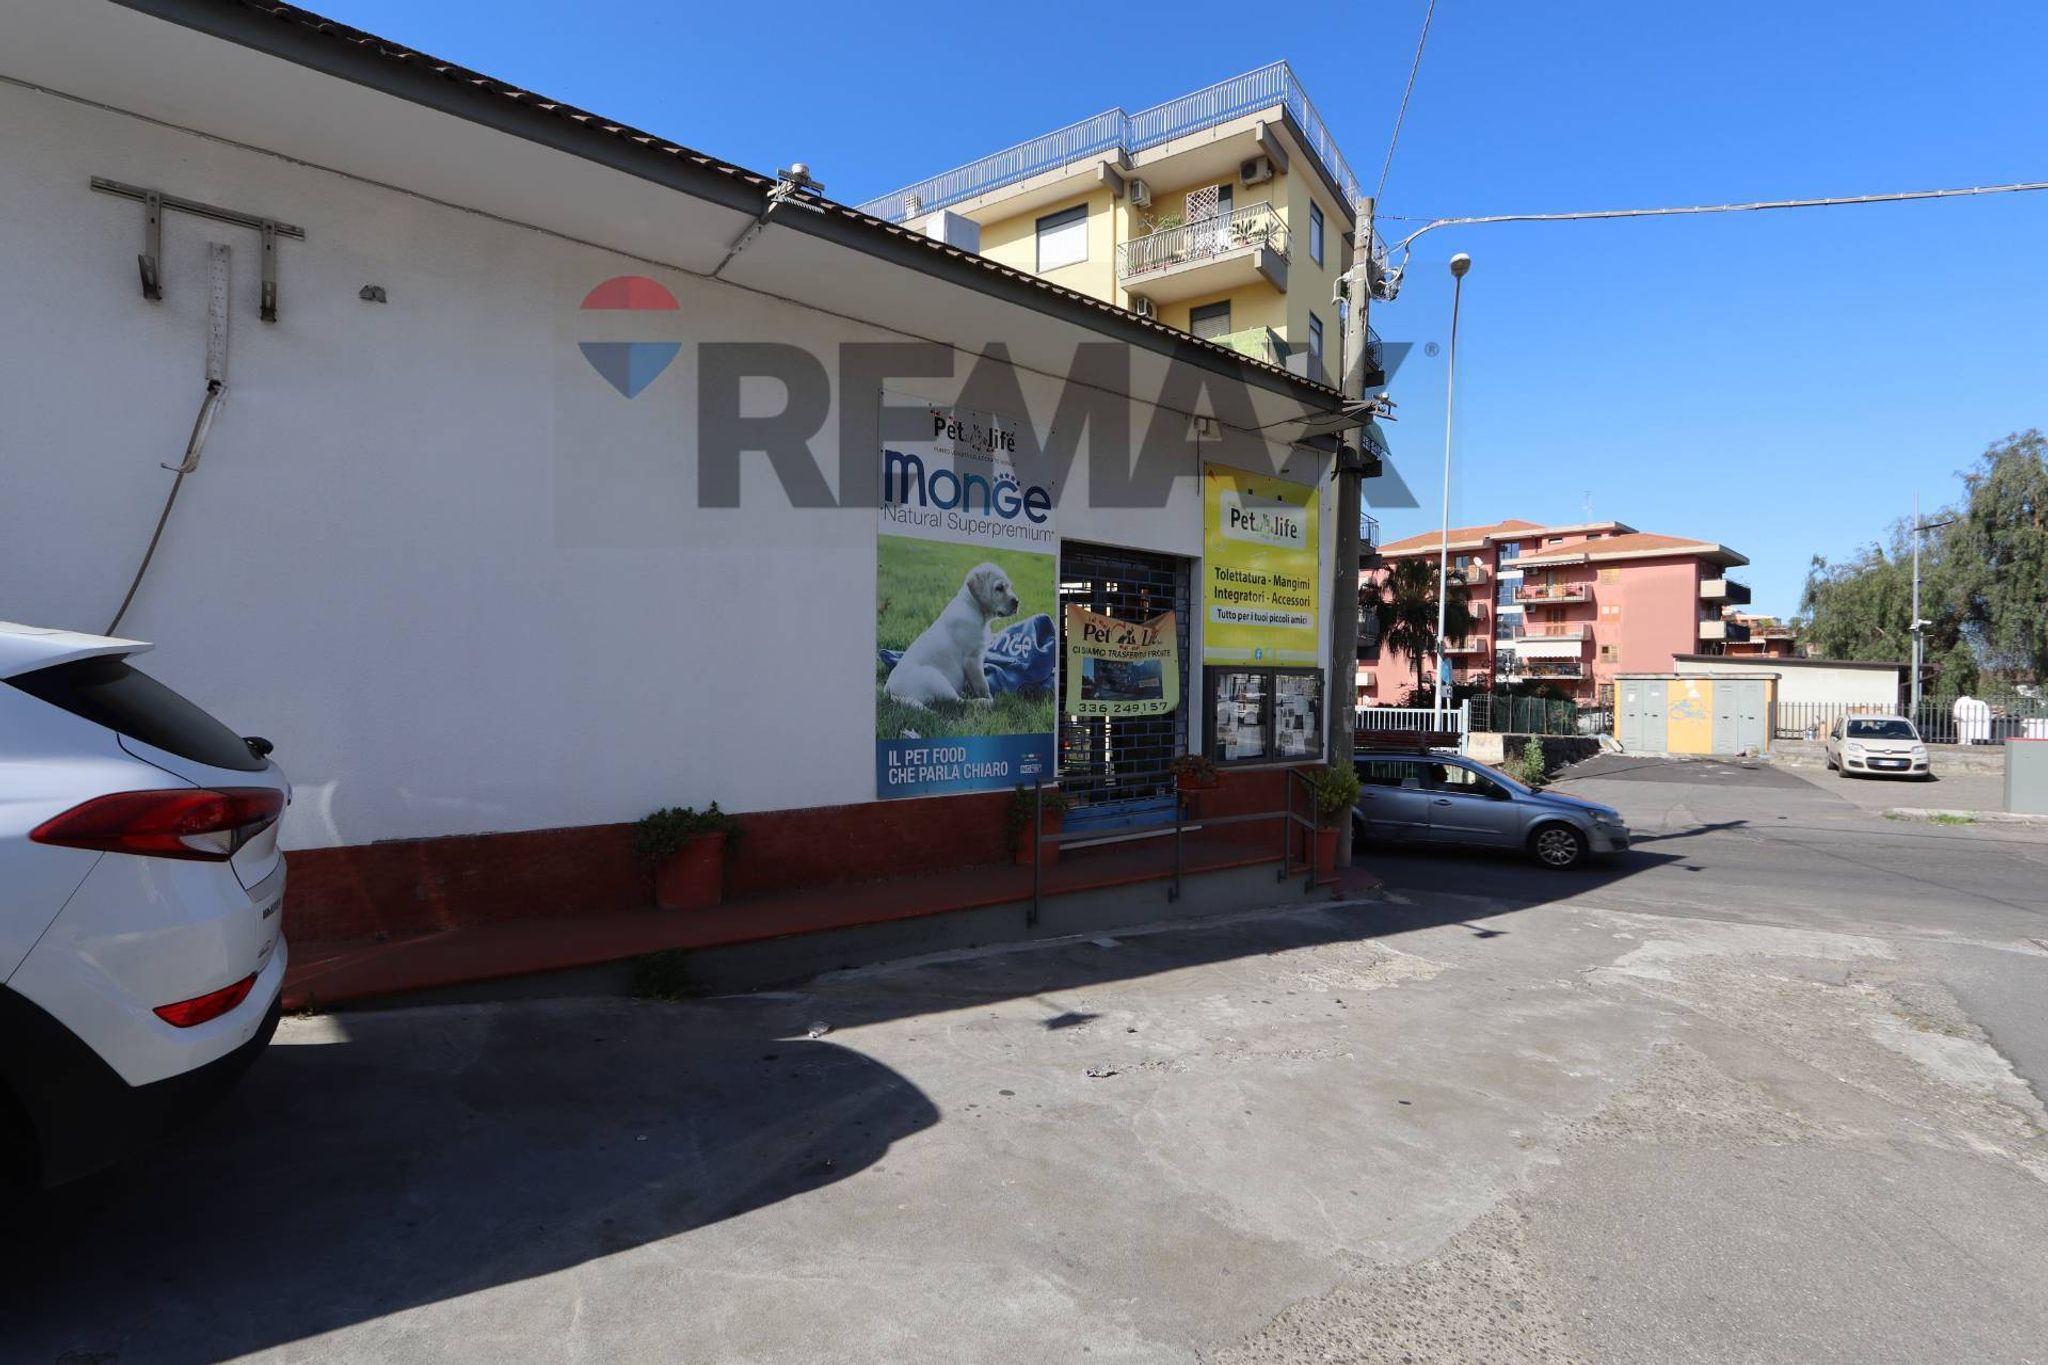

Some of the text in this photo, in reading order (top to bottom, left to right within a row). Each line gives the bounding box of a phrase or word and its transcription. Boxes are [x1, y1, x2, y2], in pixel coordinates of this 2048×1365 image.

[934, 415, 1016, 453] Pet life
[884, 503, 1051, 542] Natural Superpremium
[1230, 507, 1298, 539] Pet life
[1214, 566, 1267, 586] Tolettatura
[1273, 574, 1310, 592] Mangimi
[1214, 586, 1265, 604] Integratori
[1271, 592, 1310, 607] Accessori
[1217, 608, 1237, 620] Tutto
[1237, 612, 1249, 623] per
[1254, 612, 1268, 622] tuoi
[1269, 612, 1290, 624] piccoli
[1290, 615, 1308, 625] amici
[1083, 623, 1111, 644] Pet
[1081, 646, 1107, 658] SIAMO
[1079, 703, 1108, 713] 336
[888, 747, 967, 767] IL PET FOOD
[888, 767, 916, 785] CHE
[919, 764, 960, 782] PARLA
[963, 761, 1009, 779] CHIARO
